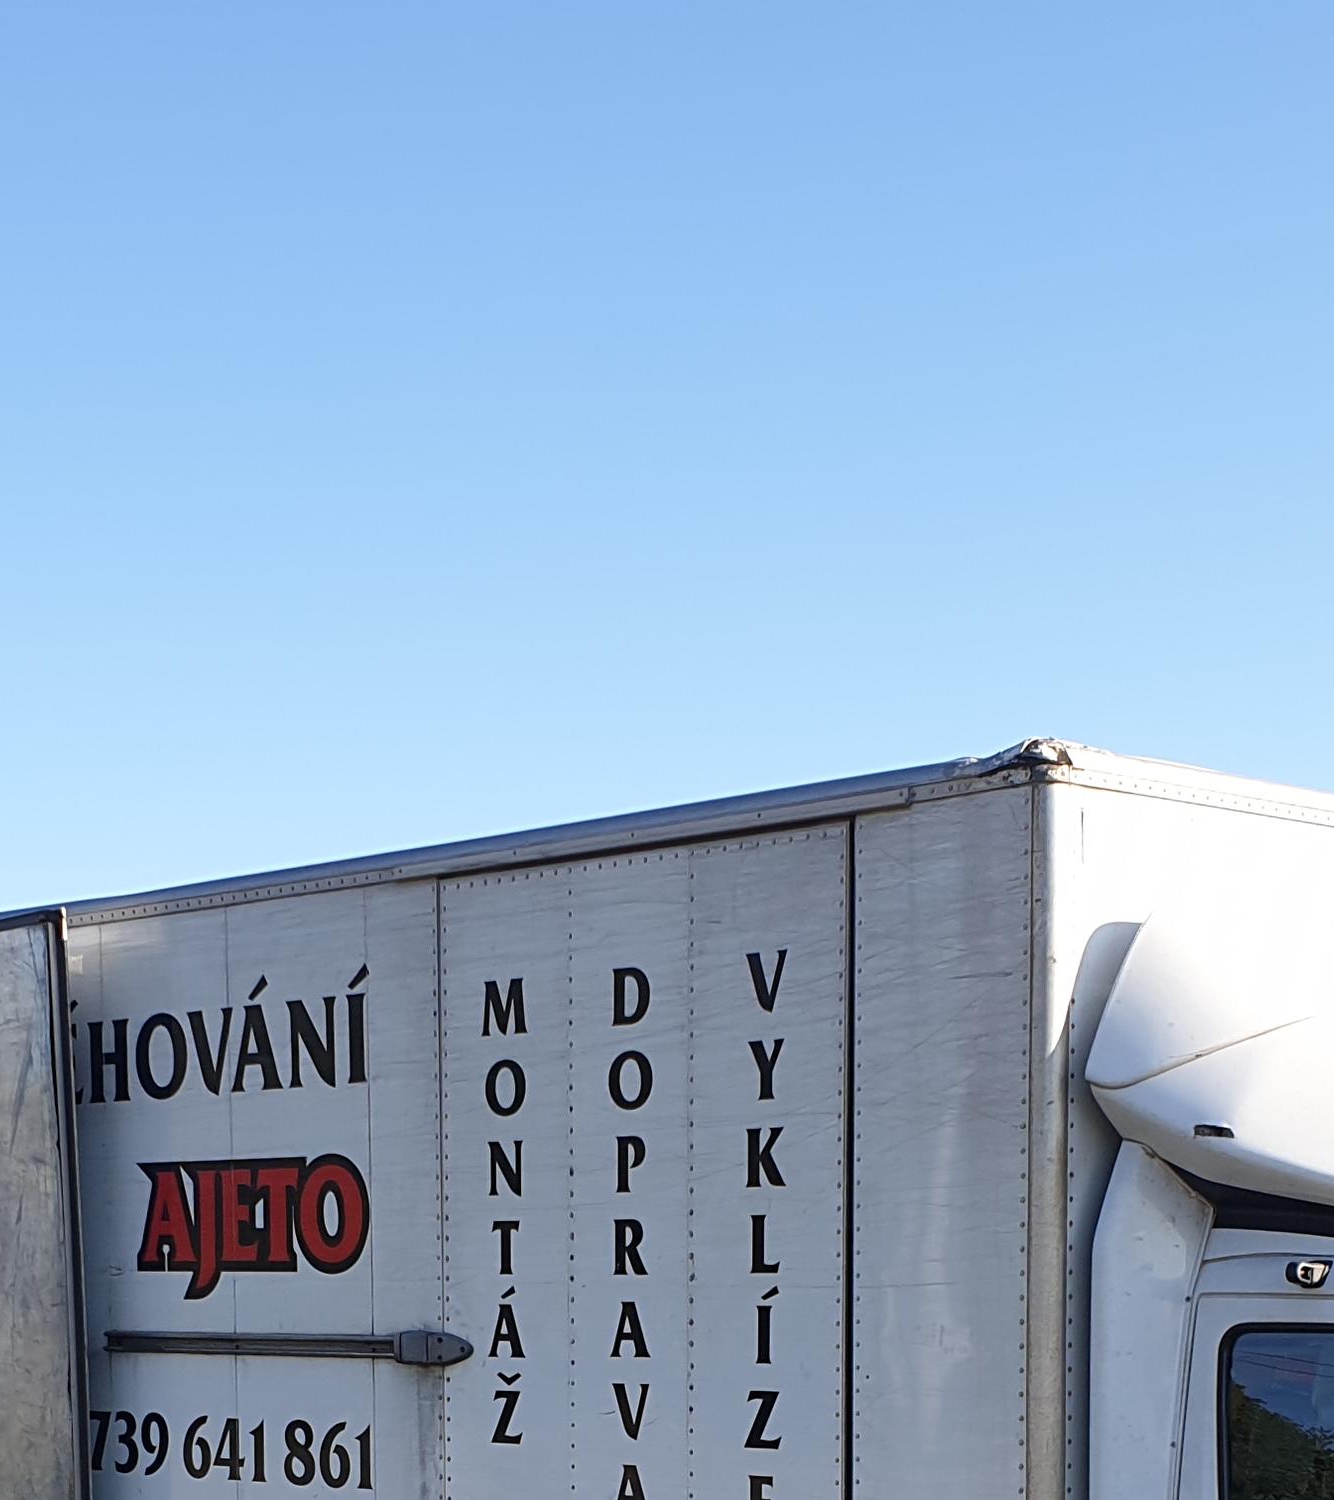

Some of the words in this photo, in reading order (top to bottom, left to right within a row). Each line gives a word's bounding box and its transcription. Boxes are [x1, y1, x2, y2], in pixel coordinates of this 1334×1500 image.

[136, 1153, 370, 1300] AJETO
[481, 977, 528, 1446] MONTÁŽ
[90, 1410, 170, 1477] 739
[183, 1415, 267, 1483] 641
[284, 1418, 373, 1491] 861
